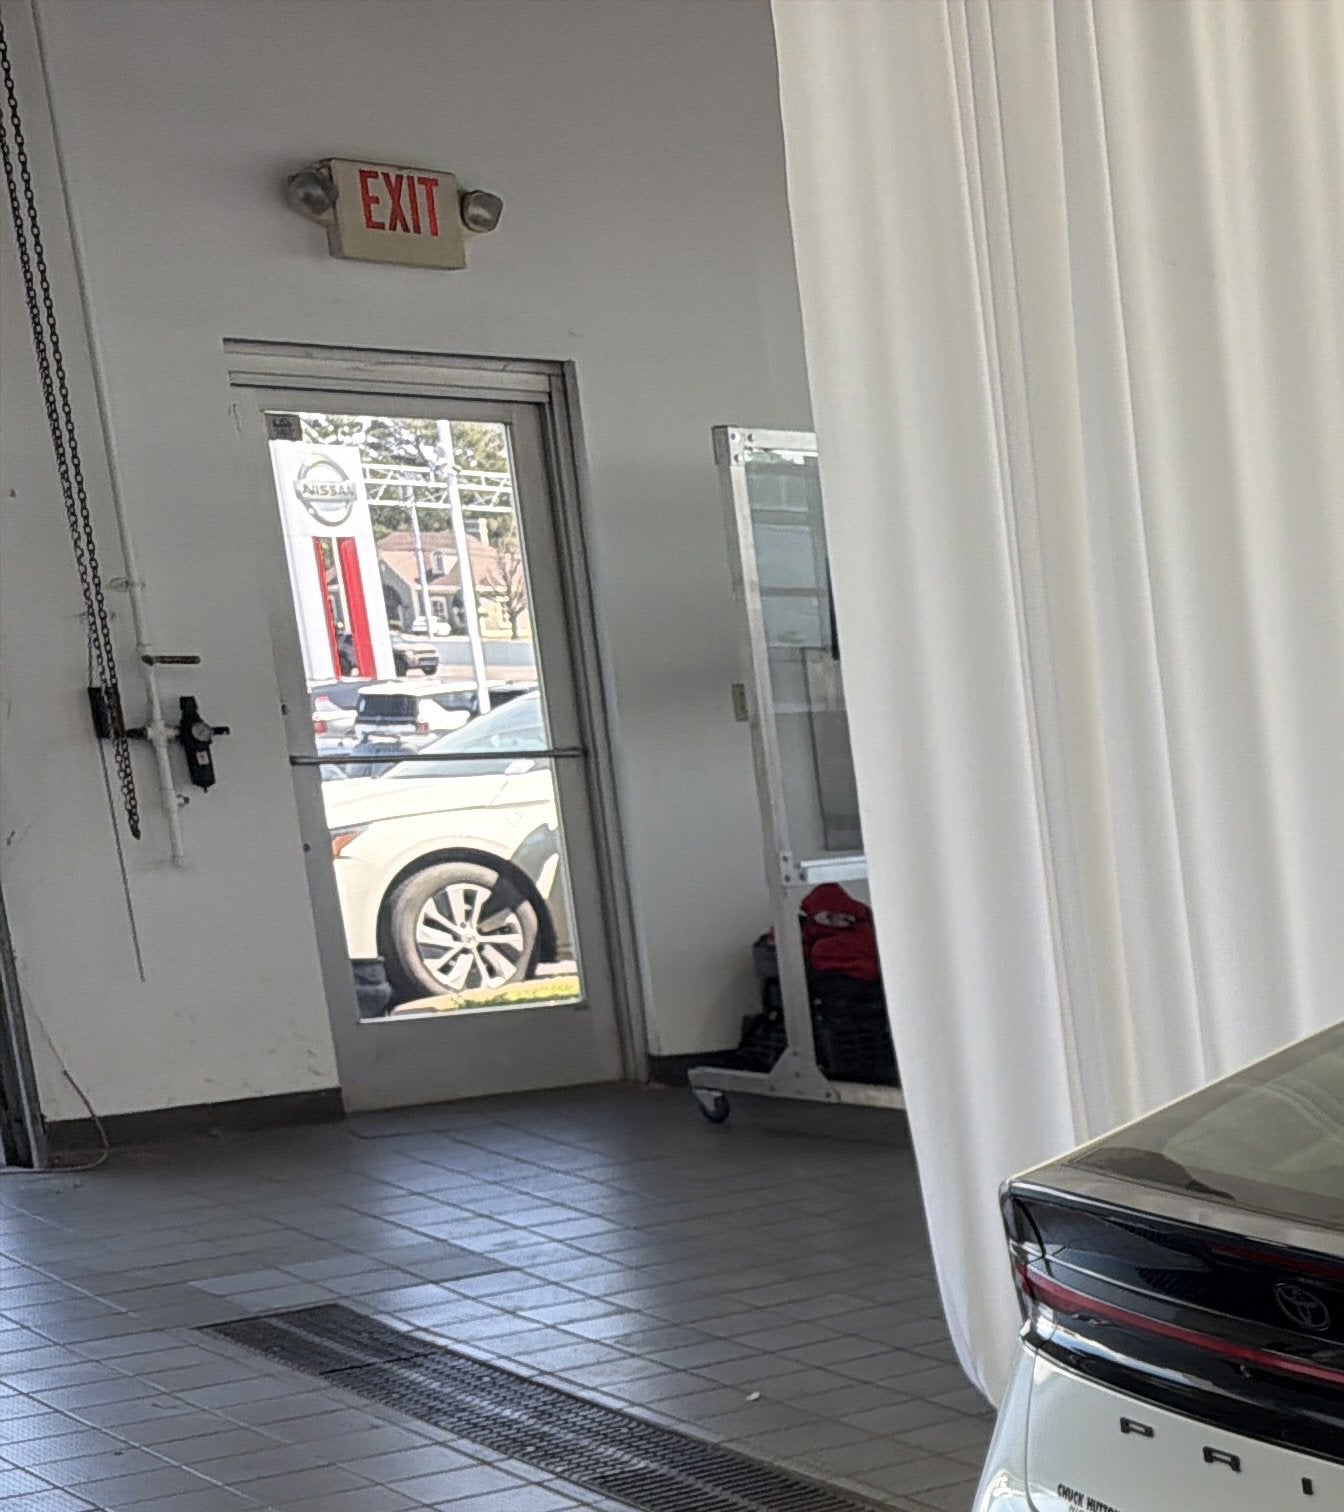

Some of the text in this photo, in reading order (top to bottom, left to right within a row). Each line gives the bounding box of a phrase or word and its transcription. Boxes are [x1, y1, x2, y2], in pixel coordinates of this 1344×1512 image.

[359, 169, 438, 236] EXIT
[302, 484, 356, 497] NISSAN
[1057, 1483, 1084, 1508] CHUCK
